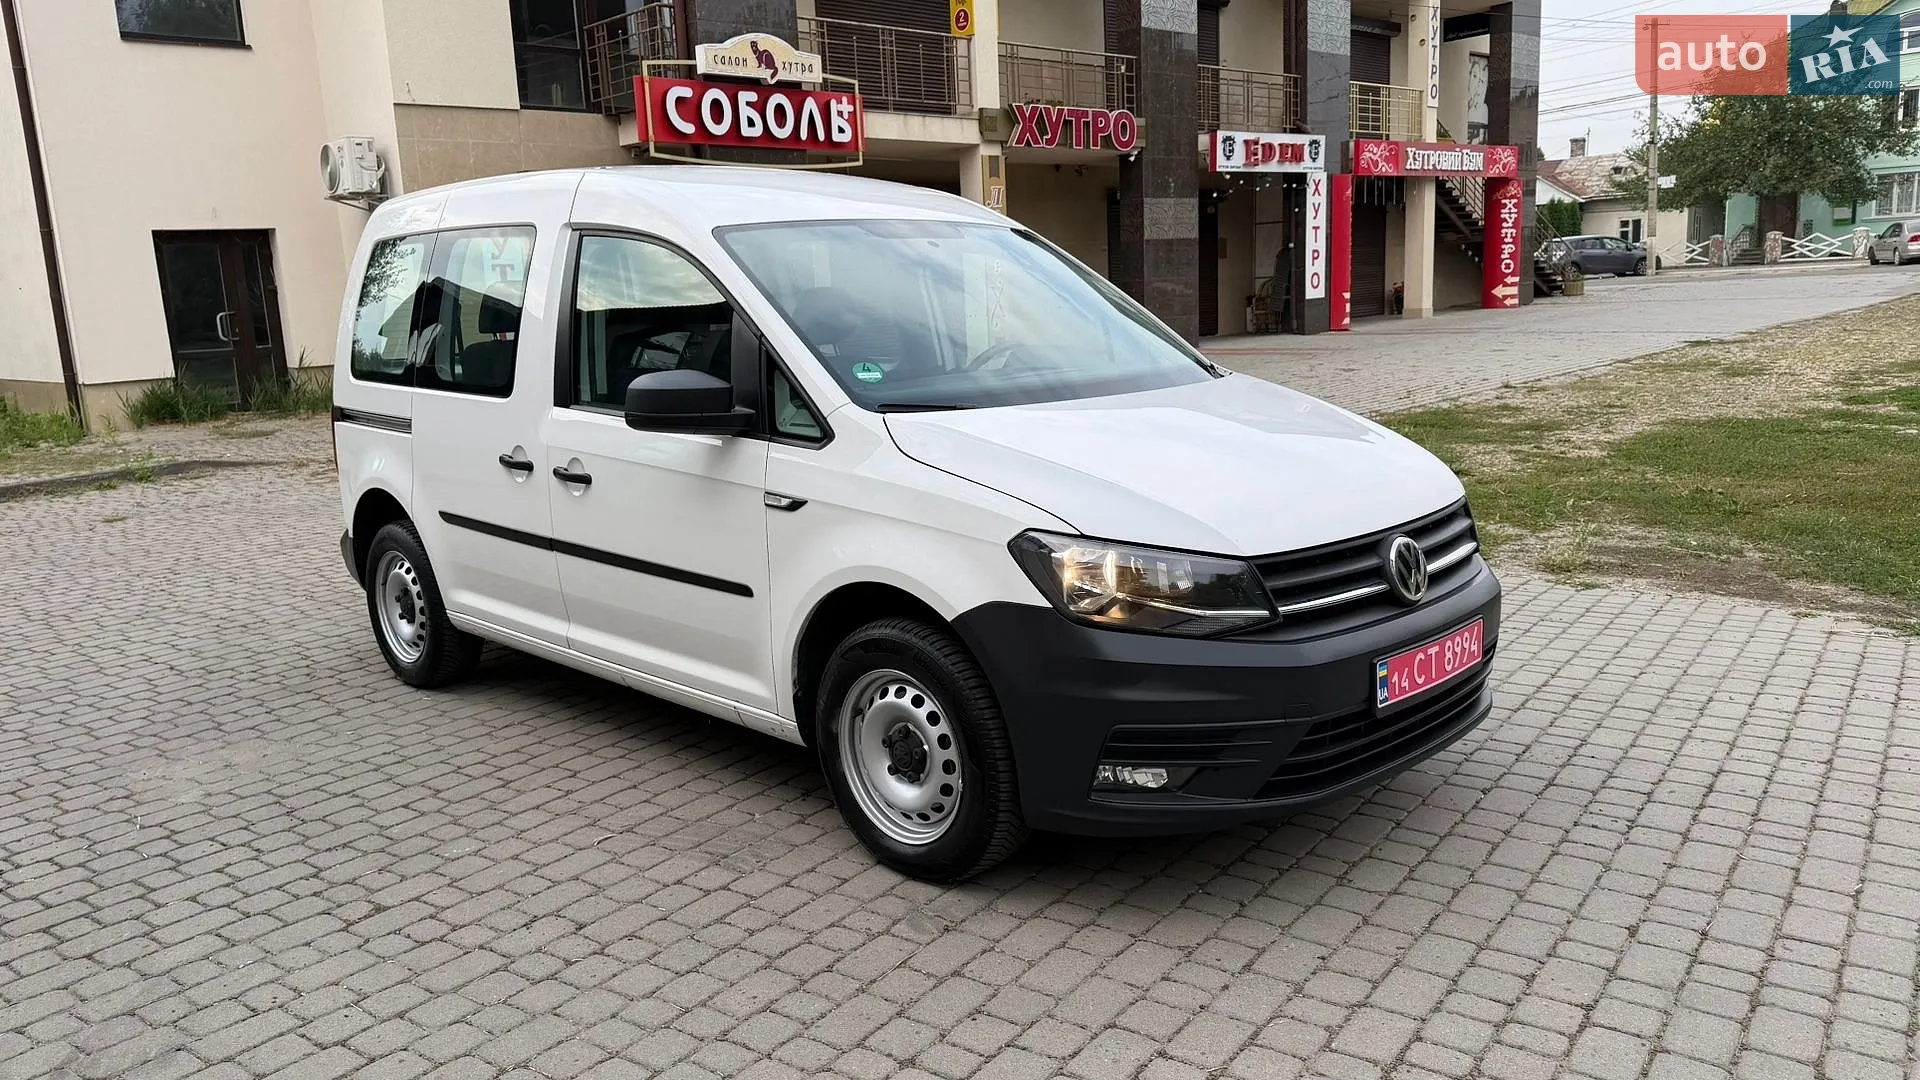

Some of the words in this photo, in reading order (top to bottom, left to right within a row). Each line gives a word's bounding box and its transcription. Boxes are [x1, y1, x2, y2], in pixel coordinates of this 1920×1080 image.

[1430, 7, 1438, 100] ХУТРО
[1008, 103, 1137, 151] ХУТРО
[1310, 178, 1322, 289] ХУТРО
[1500, 198, 1518, 272] ХУТРО
[1378, 687, 1389, 701] UA
[1391, 667, 1409, 695] 14
[1413, 646, 1439, 685] CT
[1444, 626, 1478, 672] 8994
